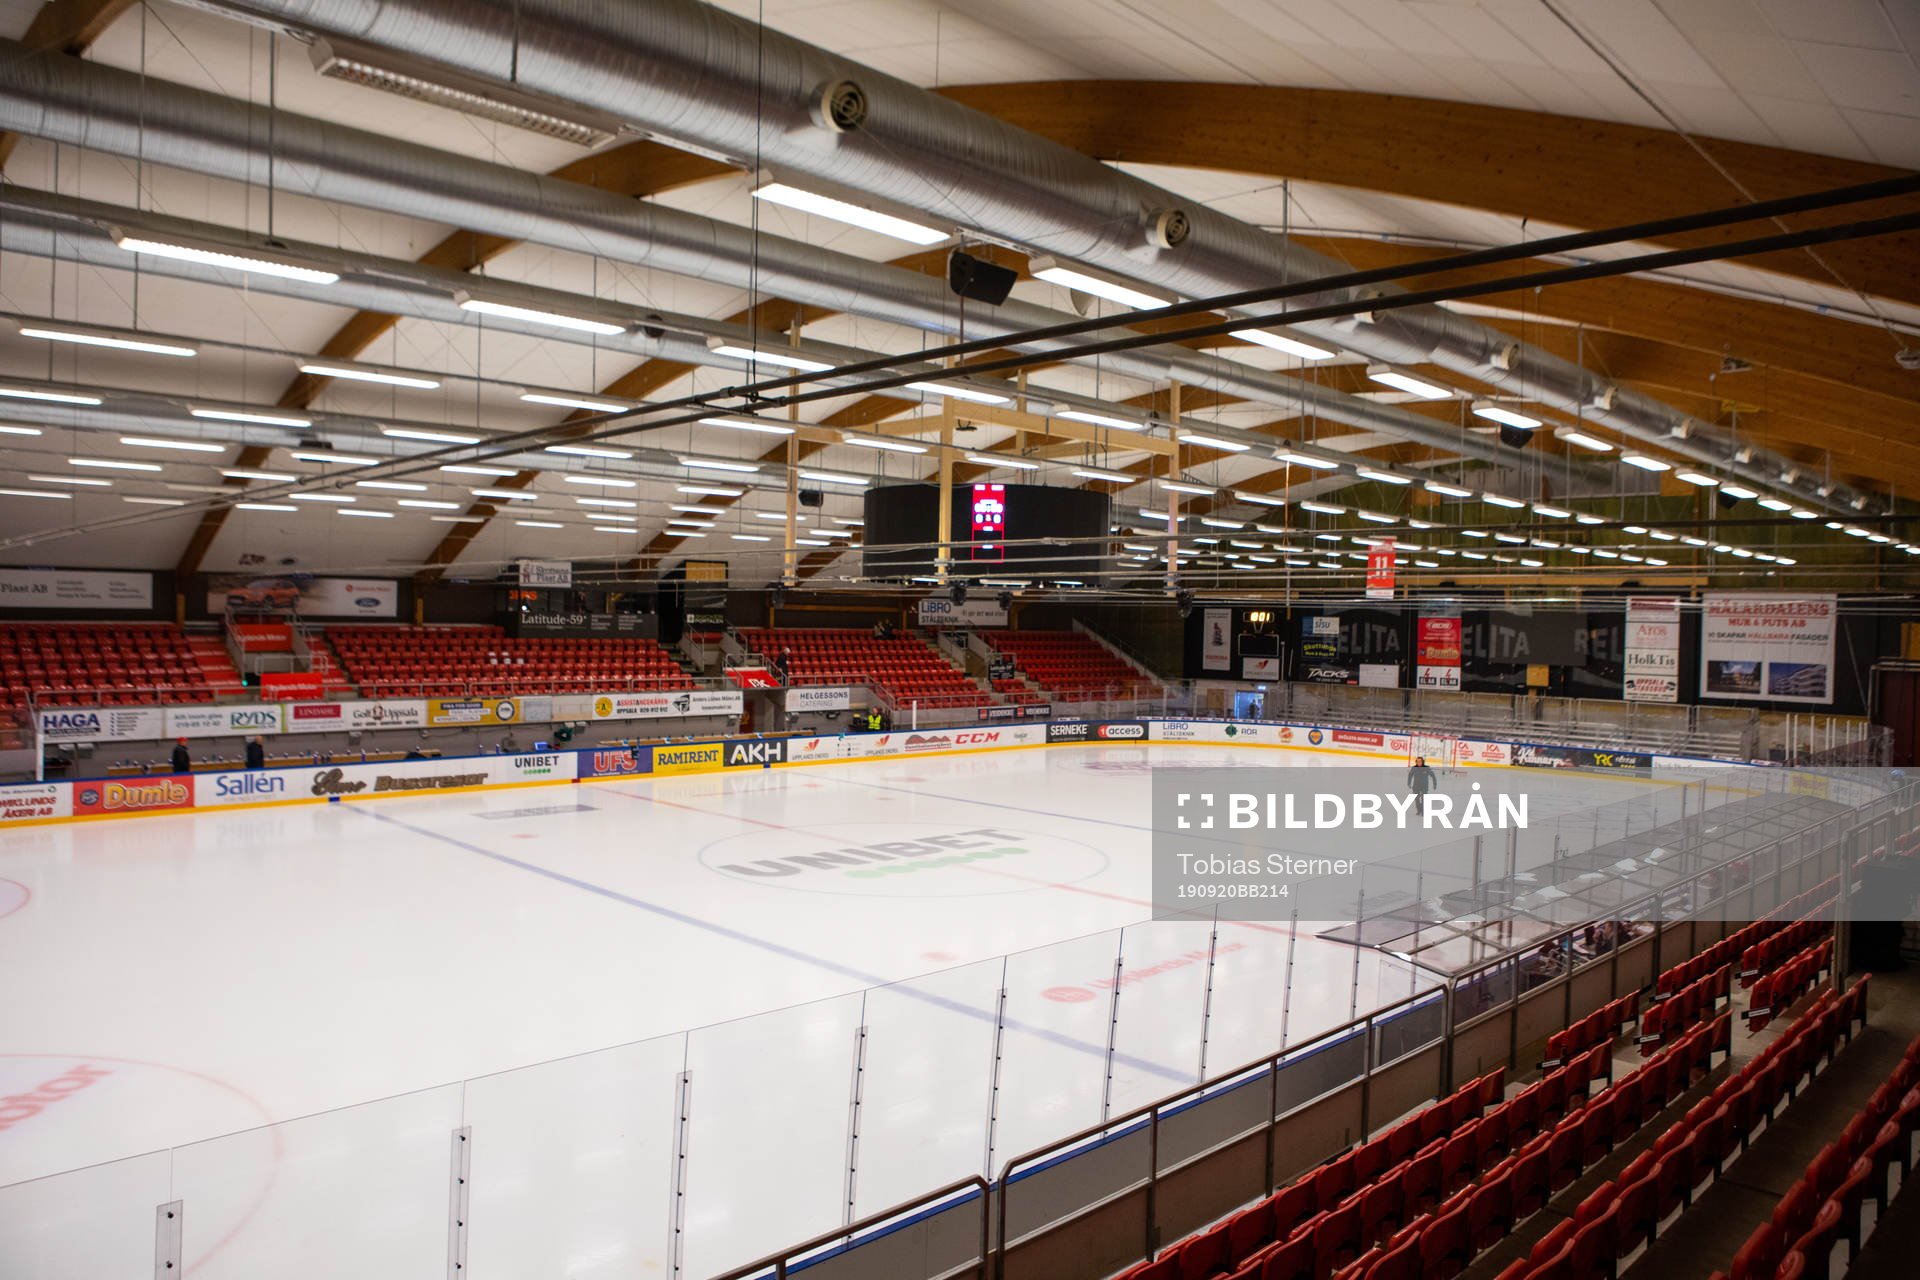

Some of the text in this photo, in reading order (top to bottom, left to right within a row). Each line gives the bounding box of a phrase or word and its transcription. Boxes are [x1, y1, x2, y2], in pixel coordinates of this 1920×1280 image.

[43, 713, 101, 728] HAGA
[1050, 724, 1088, 736] SERNEKE
[955, 732, 1000, 745] CCM
[515, 756, 559, 768] UNIBET
[594, 750, 637, 772] UFS
[657, 750, 719, 766] RAMIRENT
[730, 742, 781, 764] AKH
[215, 773, 285, 797] Sallén
[103, 781, 189, 809] Dumle
[717, 828, 1026, 878] UNIBET
